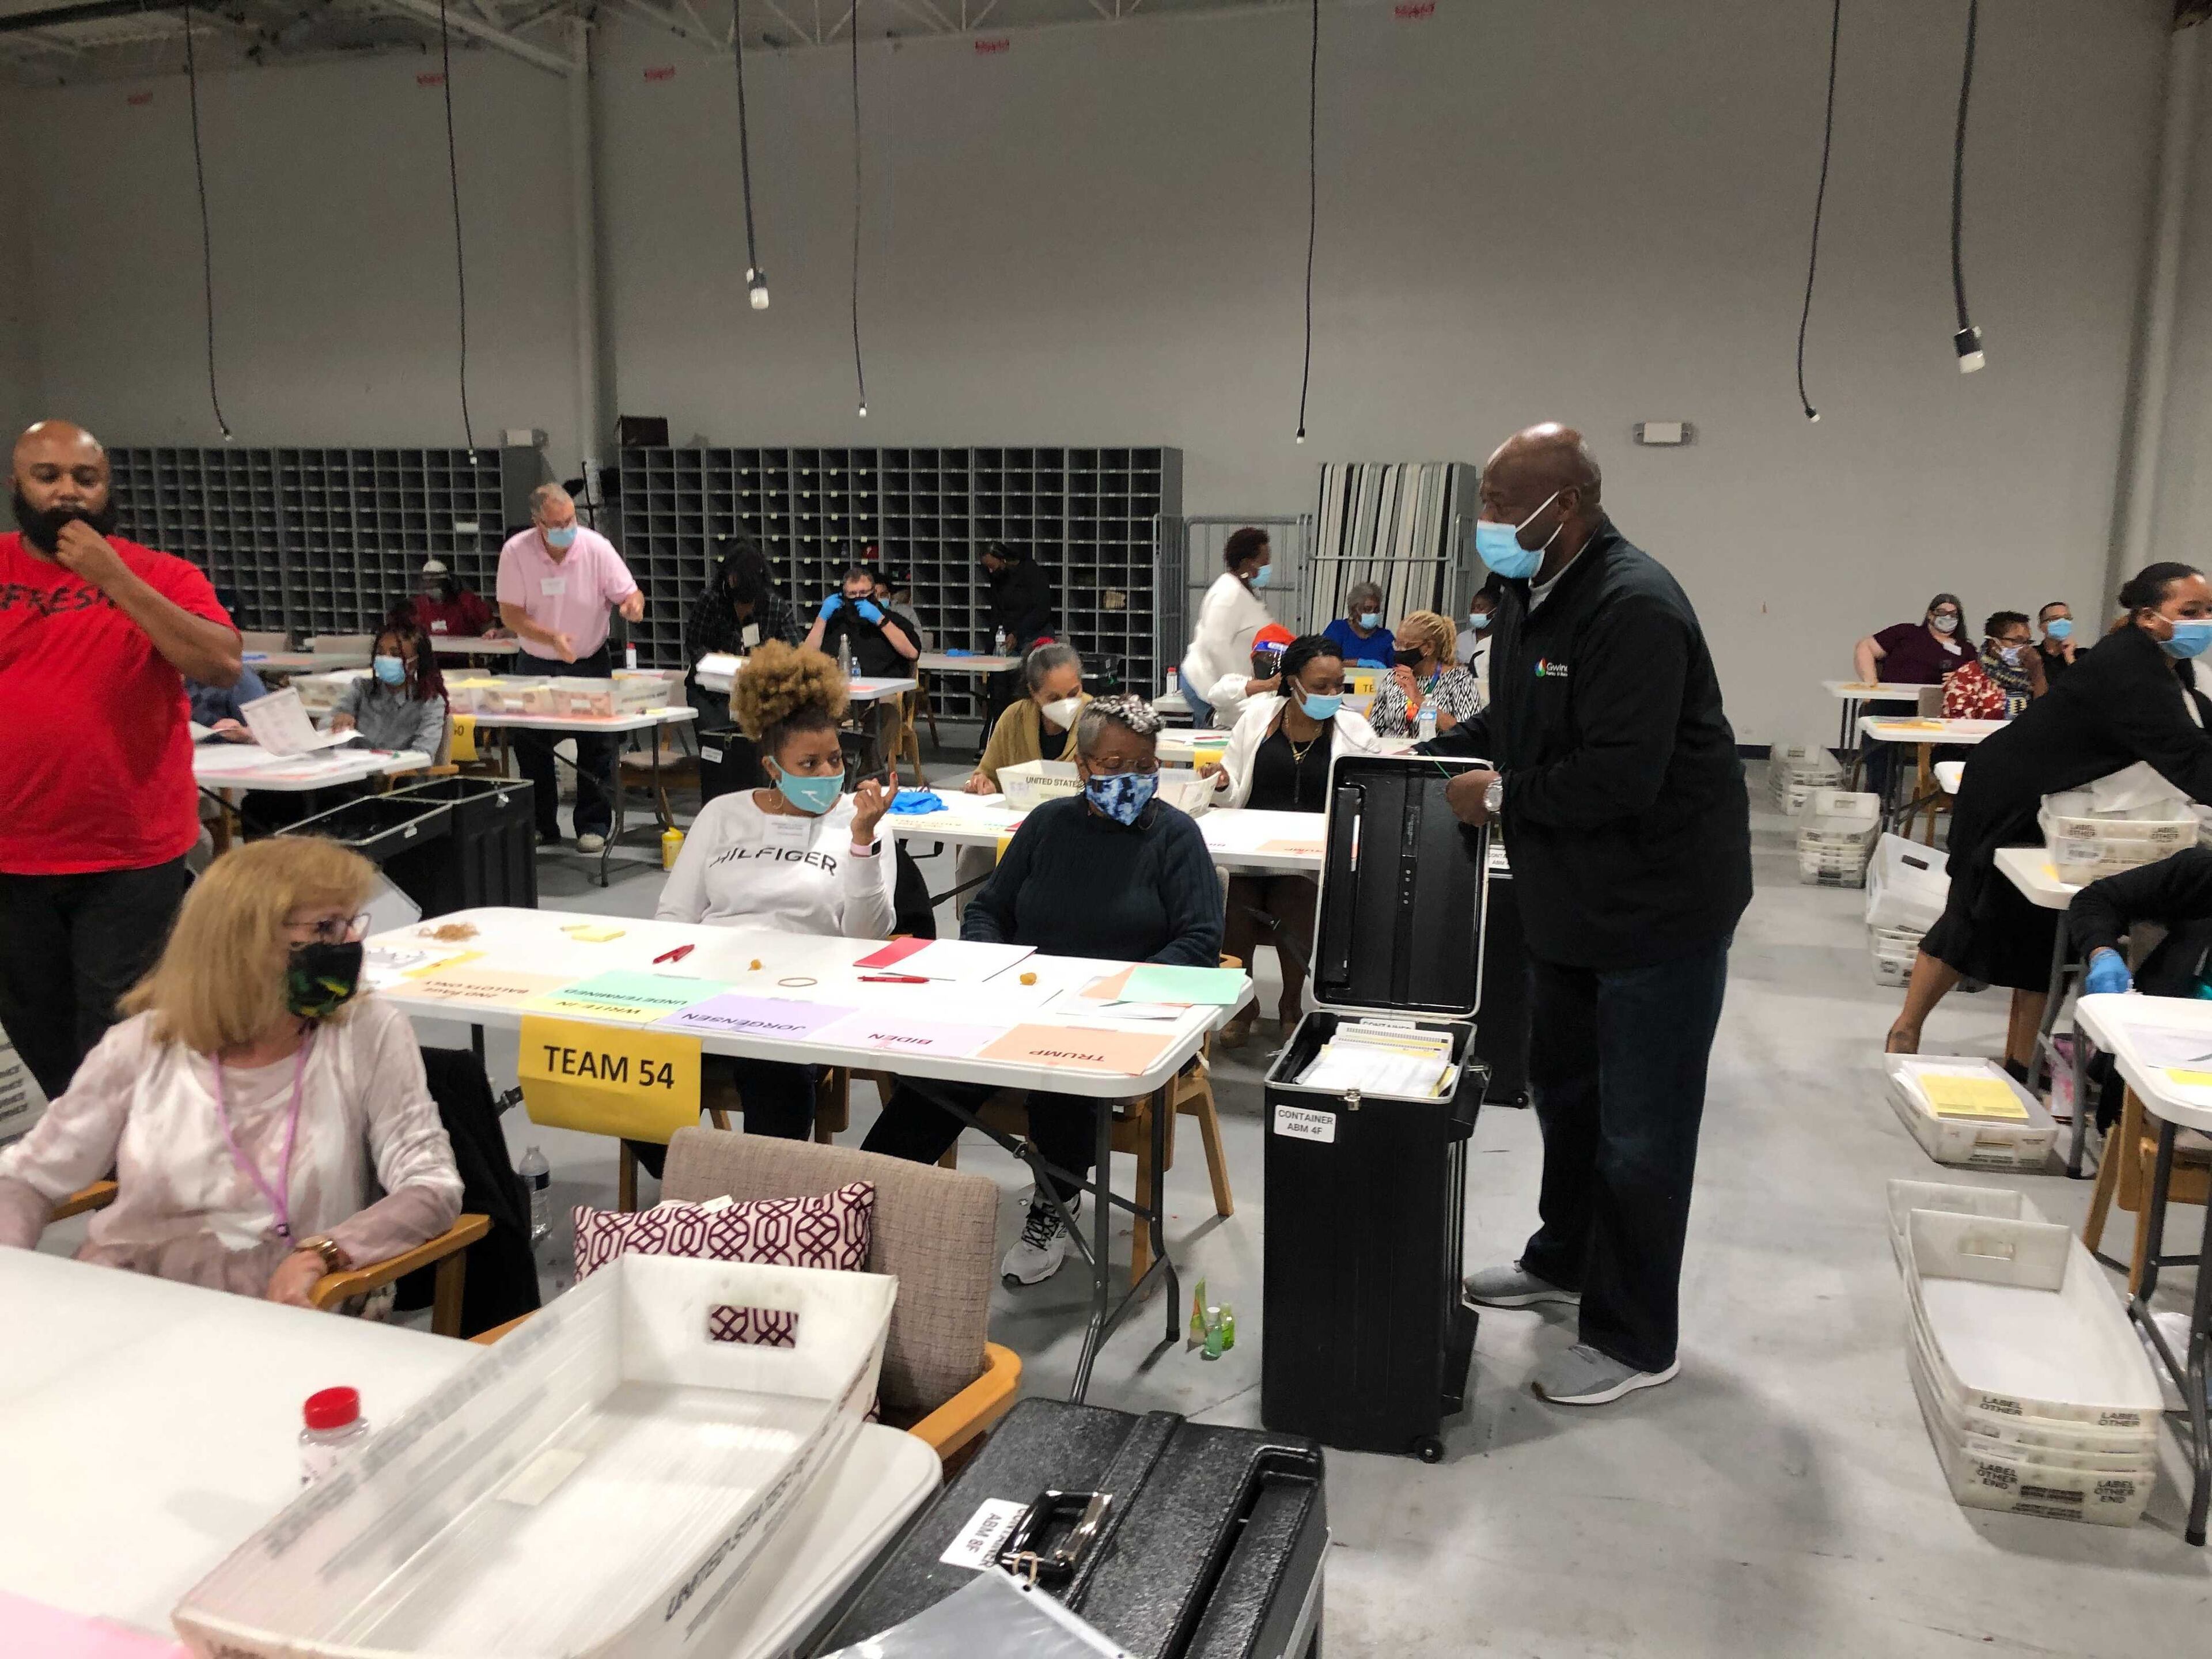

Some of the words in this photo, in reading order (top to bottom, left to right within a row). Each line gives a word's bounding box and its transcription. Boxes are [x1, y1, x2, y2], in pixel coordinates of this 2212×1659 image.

[1363, 684, 1374, 693] TE
[1026, 777, 1052, 786] UNITED
[564, 988, 688, 1005] UNDETERMINED
[682, 1013, 806, 1032] JORGENSEN
[868, 1033, 933, 1046] BIDEN
[1028, 1049, 1105, 1062] TRUMP
[543, 1045, 629, 1084] TEAM
[639, 1059, 675, 1090] 54
[1279, 1109, 1334, 1125] CONTAINER
[1287, 1123, 1309, 1133] ABM
[1310, 1127, 1323, 1135] 4F
[1979, 1403, 2023, 1416] OTHER
[1982, 1396, 2023, 1410] LABEL
[975, 1513, 1002, 1537] ABM
